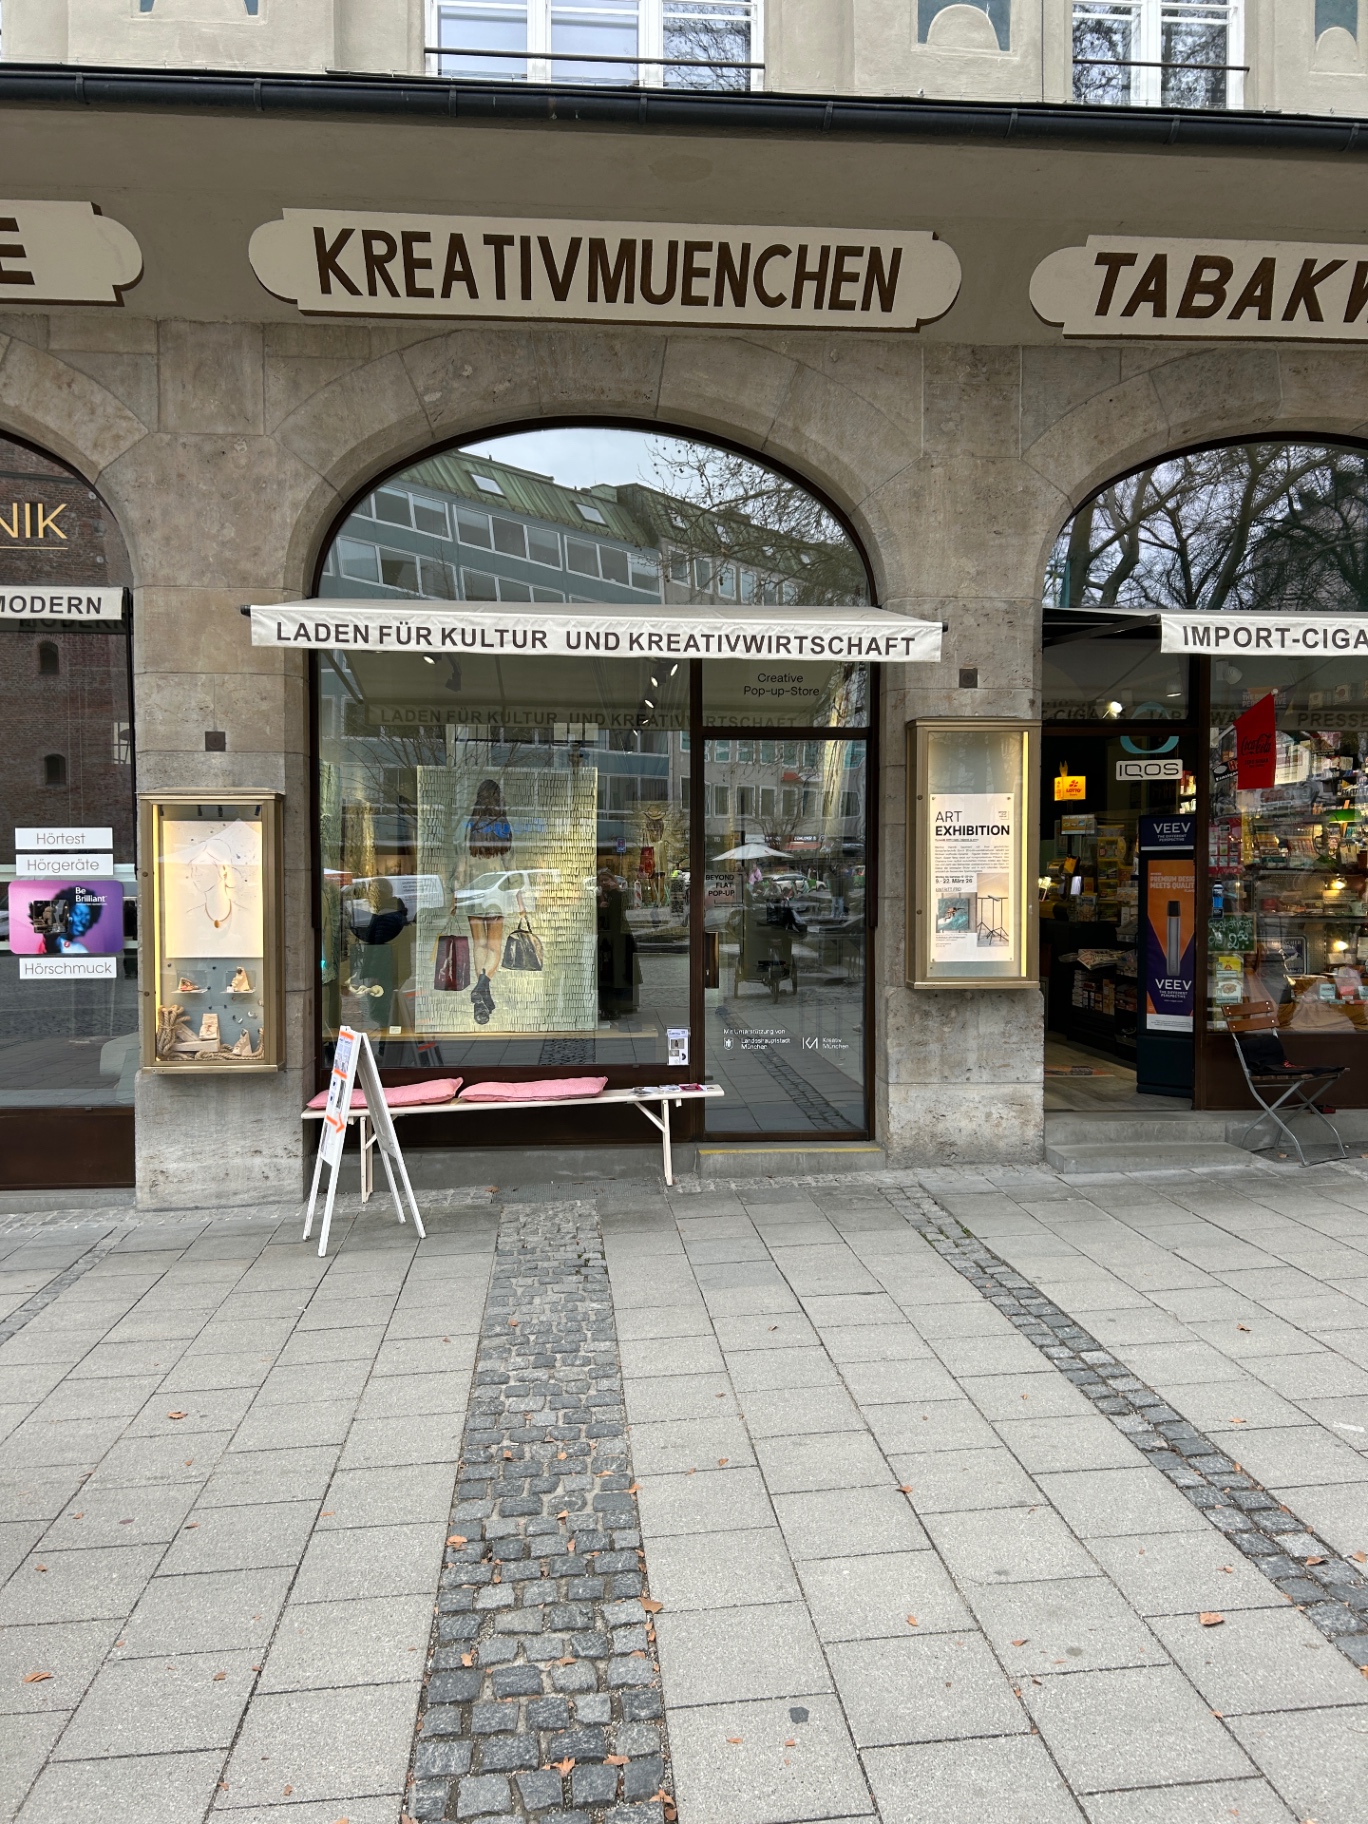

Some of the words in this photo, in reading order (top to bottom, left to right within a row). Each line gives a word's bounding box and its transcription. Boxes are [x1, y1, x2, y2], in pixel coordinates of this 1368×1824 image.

[312, 226, 903, 312] KREATIVMUENCHEN
[276, 621, 369, 644] LADEN
[378, 622, 432, 646] FÜR
[440, 627, 548, 649] KULTUR
[566, 630, 621, 651] UND
[629, 632, 915, 656] KREATIVWIRTSCHAFT
[1182, 625, 1368, 649] IMPORT-CIGA
[757, 672, 804, 683] Creative
[743, 686, 820, 697] Pop-up-Store
[381, 709, 441, 723] LADEN
[446, 707, 483, 724] FÜR
[1119, 762, 1179, 778] IQOS
[935, 810, 962, 823] ART
[935, 825, 1011, 836] EXHIBITION
[1153, 822, 1191, 834] VEEV
[36, 833, 86, 845] Hörtest
[27, 858, 100, 874] Hörgeräte
[75, 886, 87, 895] Be
[24, 962, 113, 975] Hörschmuck
[1155, 978, 1192, 991] VEEV
